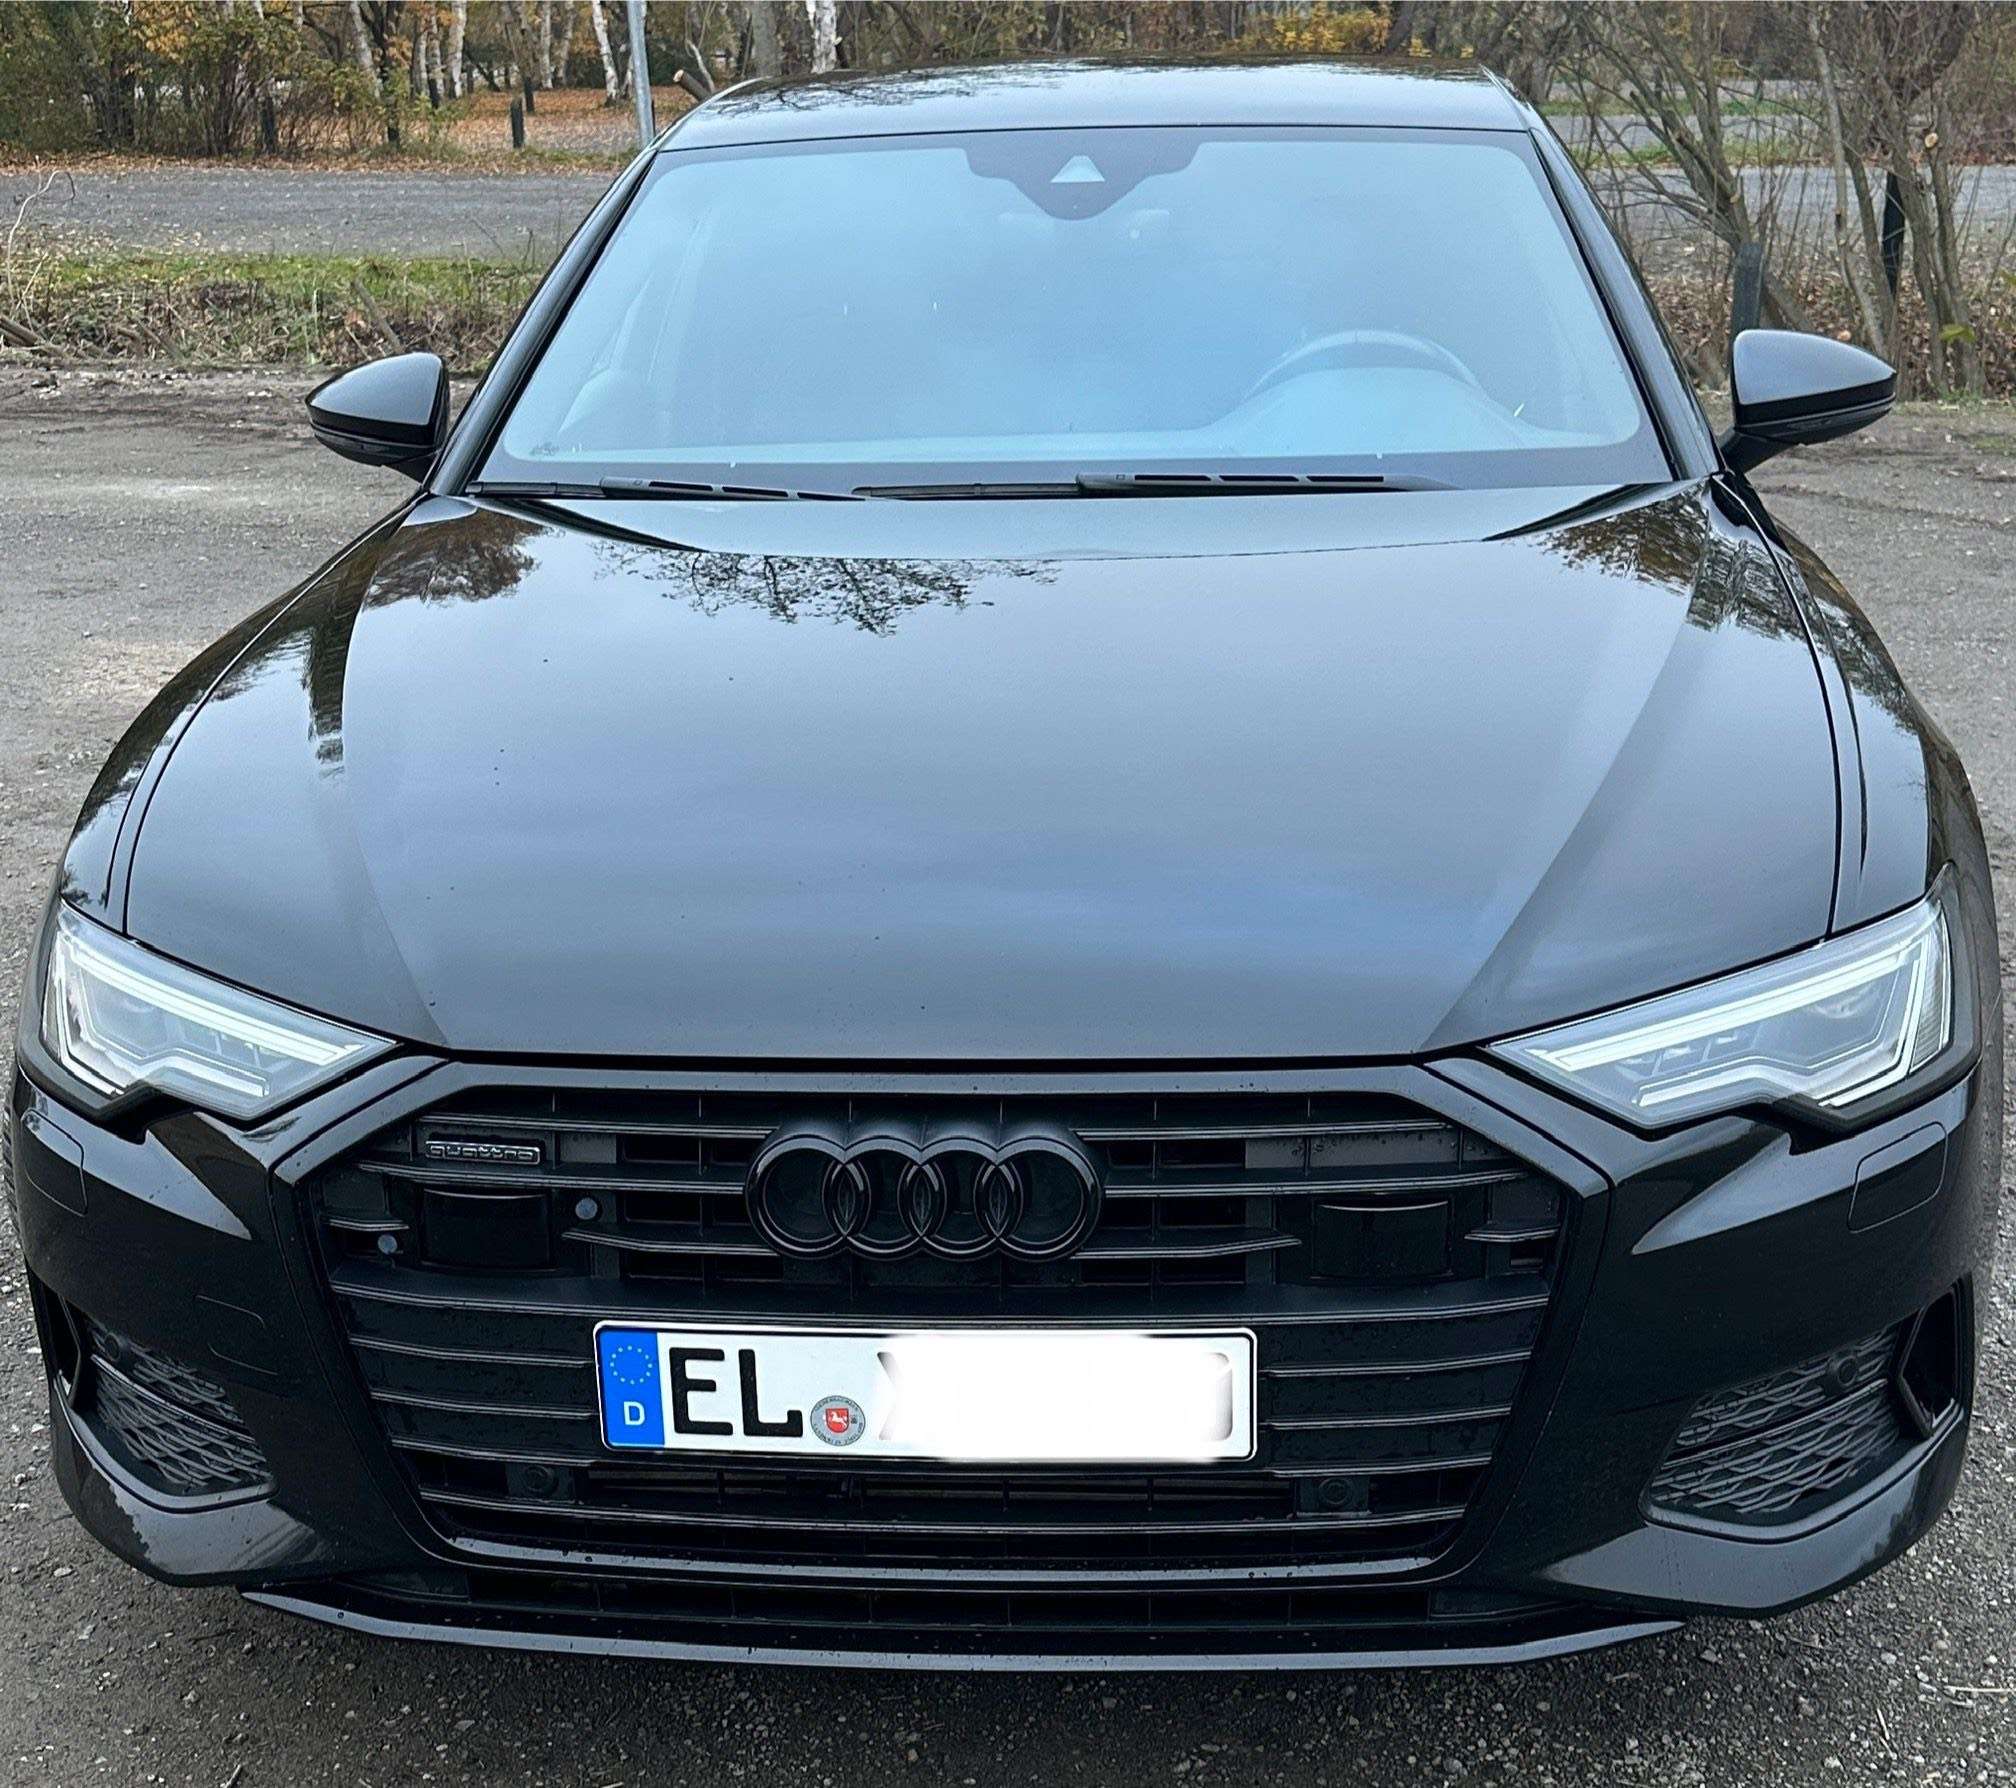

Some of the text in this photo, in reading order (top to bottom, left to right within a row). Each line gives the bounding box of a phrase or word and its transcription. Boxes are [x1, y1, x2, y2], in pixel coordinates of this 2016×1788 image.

[429, 1144, 534, 1160] quattro
[669, 1347, 803, 1437] EL
[623, 1401, 645, 1425] D
